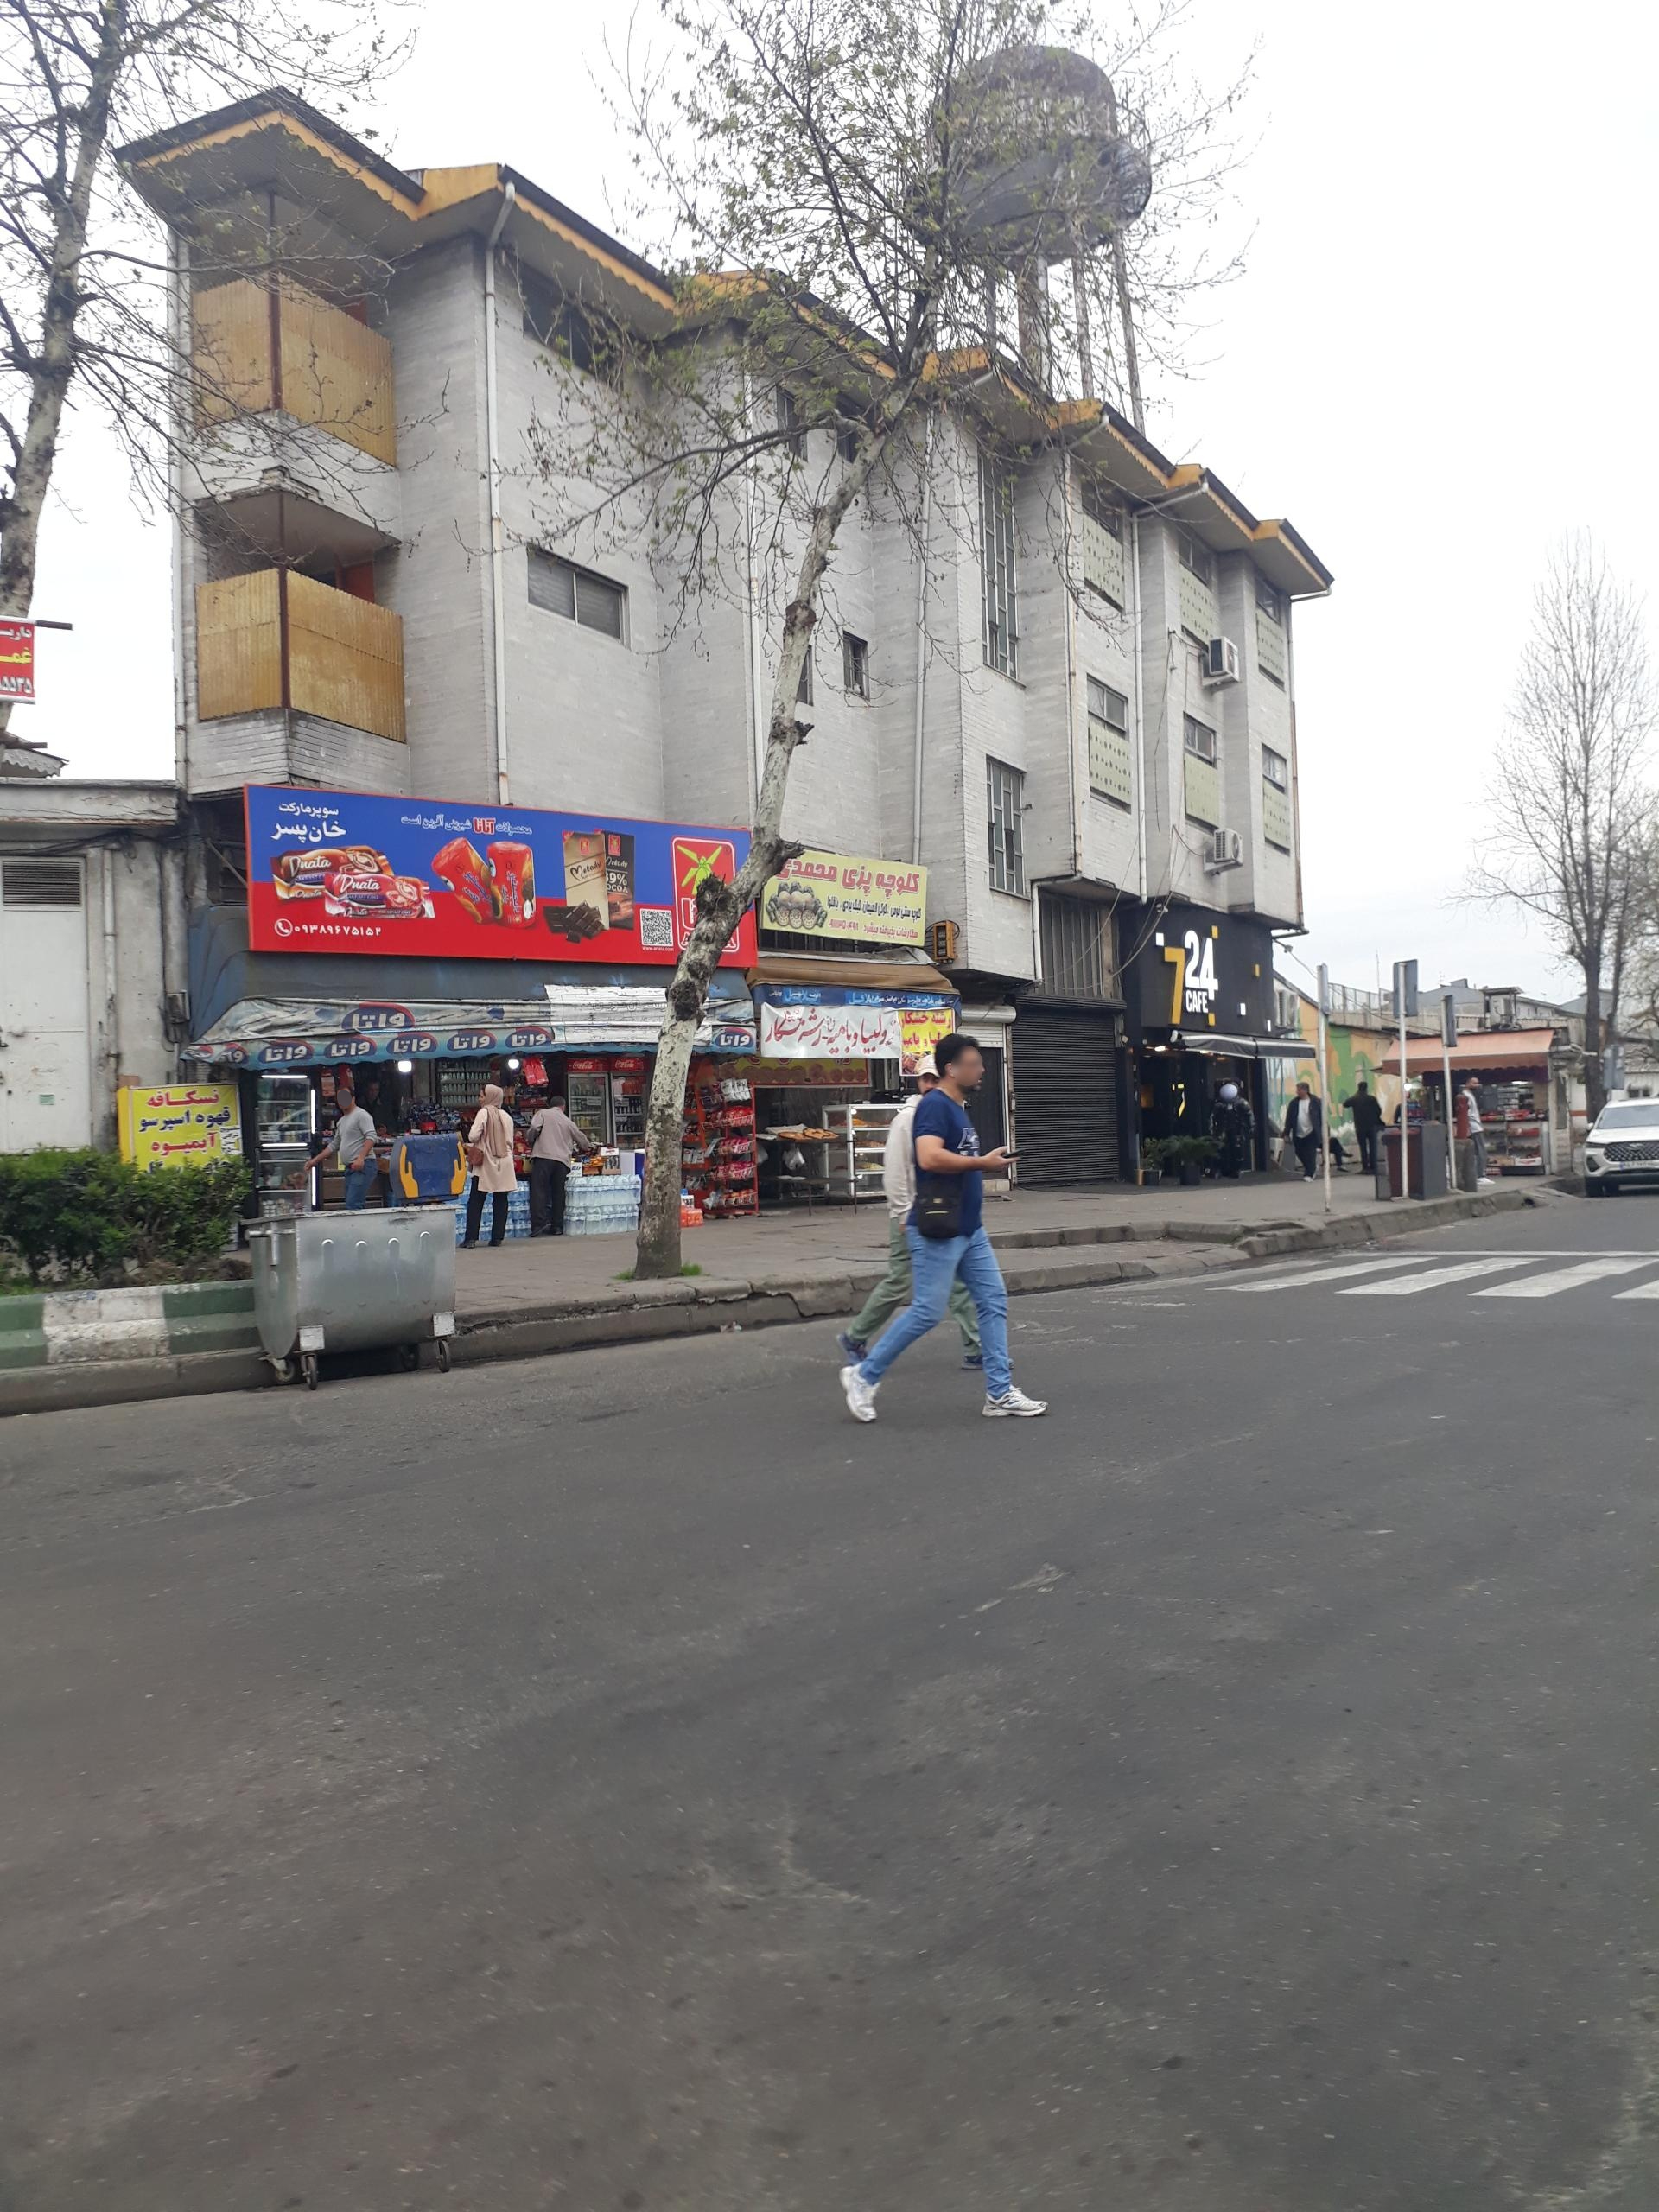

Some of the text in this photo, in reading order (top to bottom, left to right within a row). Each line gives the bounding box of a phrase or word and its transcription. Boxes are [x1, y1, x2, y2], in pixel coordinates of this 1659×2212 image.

[278, 802, 340, 818] سوپرمارکت
[400, 814, 422, 826] است
[444, 819, 473, 831] شیرینی
[495, 821, 533, 836] محصولات
[842, 865, 873, 896] پزی
[875, 872, 920, 899] کلوچه
[1185, 989, 1209, 1014] CAFE
[393, 1038, 431, 1053] واتا
[454, 1035, 491, 1050] واتا
[511, 1033, 547, 1048] واتا
[331, 1041, 372, 1057] واتا
[147, 1089, 221, 1108] نسکافه
[195, 1106, 232, 1128] قهوه
[151, 1130, 219, 1157] آبمیوه
